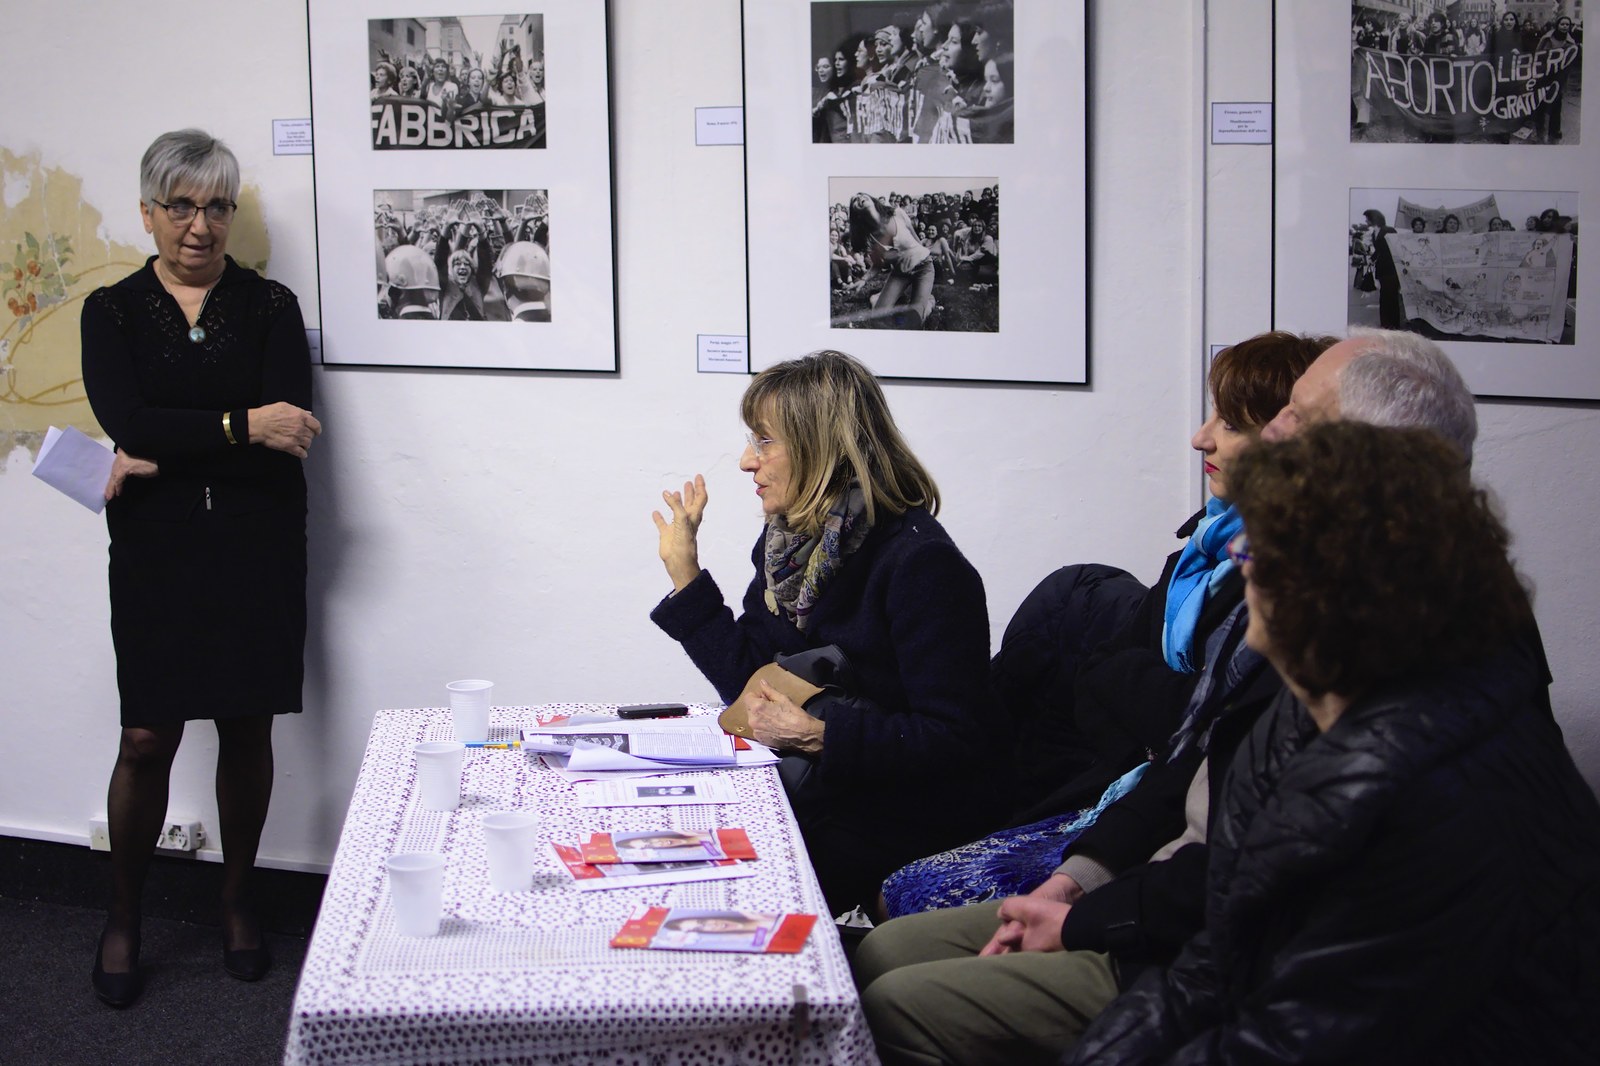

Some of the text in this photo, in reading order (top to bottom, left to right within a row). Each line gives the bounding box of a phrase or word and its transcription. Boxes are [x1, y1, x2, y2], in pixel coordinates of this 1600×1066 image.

[1365, 52, 1497, 116] ABORTO
[1497, 45, 1579, 83] LIBERO
[1525, 78, 1537, 91] e
[371, 103, 537, 148] FABBRICA
